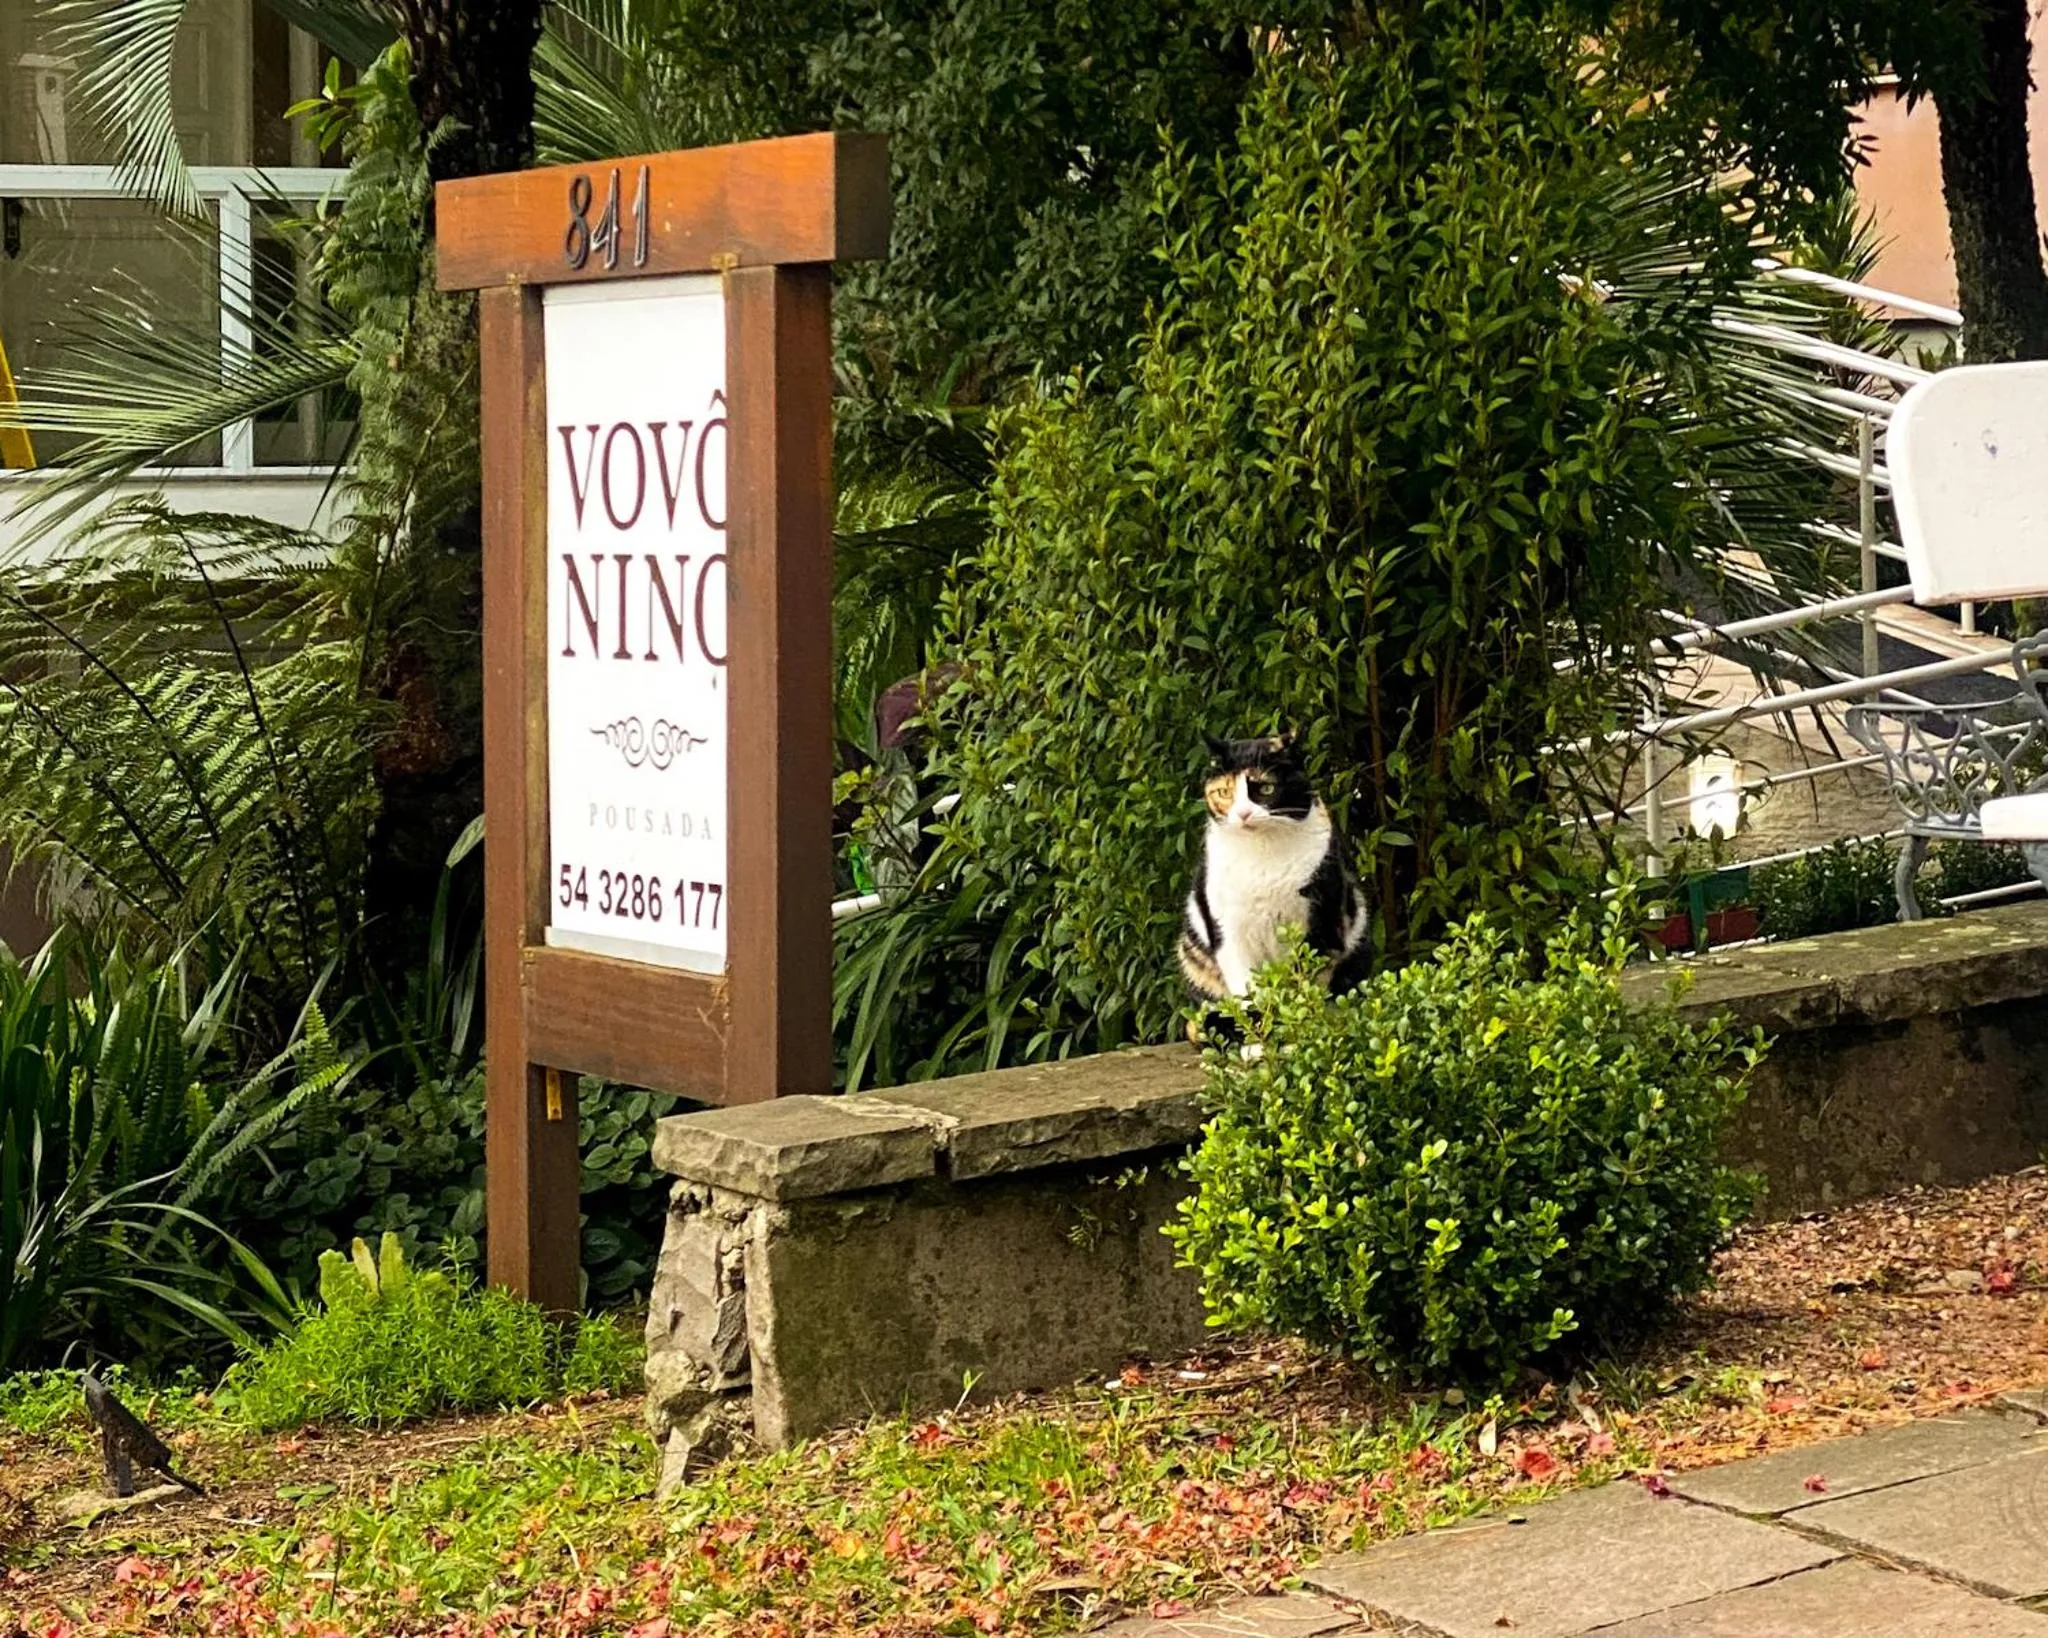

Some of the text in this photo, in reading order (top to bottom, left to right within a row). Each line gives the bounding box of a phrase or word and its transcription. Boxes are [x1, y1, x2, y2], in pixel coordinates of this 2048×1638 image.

[564, 164, 648, 270] 841
[589, 802, 712, 840] POUSADA
[559, 863, 722, 929] 54 3286 177
